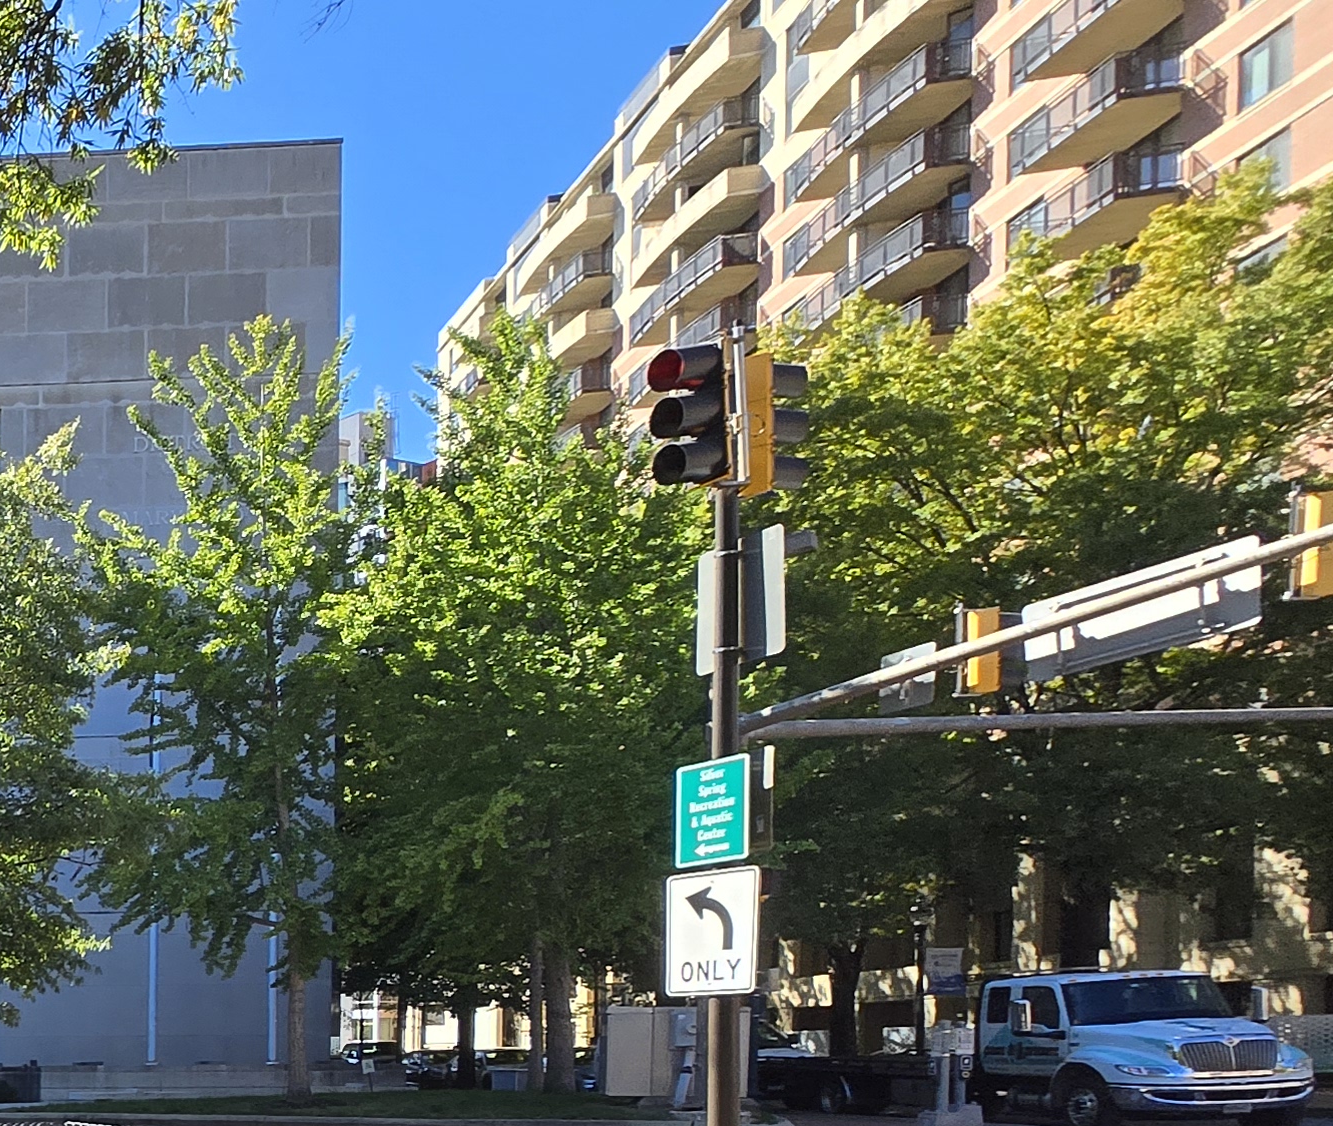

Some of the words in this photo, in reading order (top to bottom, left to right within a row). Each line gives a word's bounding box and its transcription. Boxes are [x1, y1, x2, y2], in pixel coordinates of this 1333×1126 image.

[134, 433, 238, 453] DITRT
[699, 768, 726, 782] Silver
[697, 782, 727, 798] Spring
[688, 796, 736, 813] Recreation
[690, 817, 699, 828] &
[700, 810, 734, 827] Aquatic
[697, 828, 727, 842] Center
[681, 958, 741, 983] ONLY
